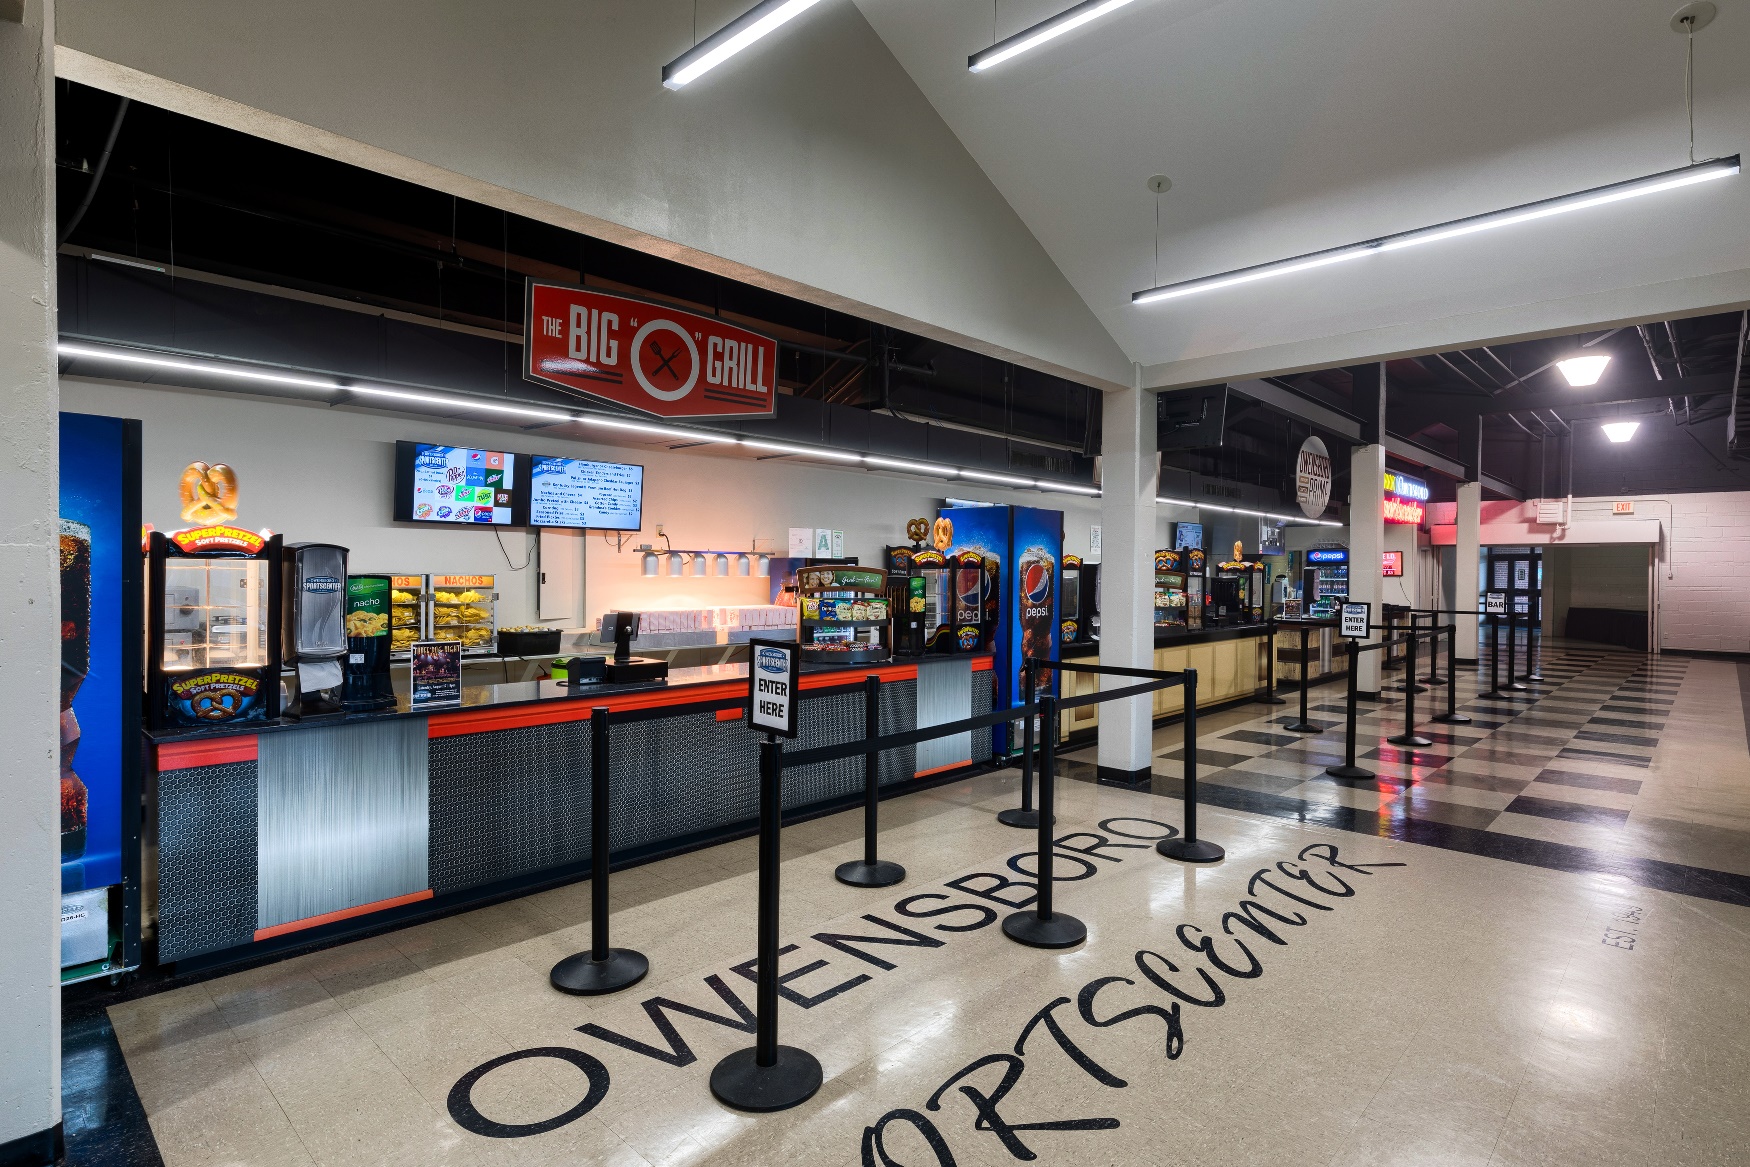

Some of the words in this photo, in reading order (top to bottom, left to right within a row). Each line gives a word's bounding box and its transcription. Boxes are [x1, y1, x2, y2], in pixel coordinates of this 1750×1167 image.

[542, 316, 562, 338] THE
[568, 304, 619, 366] BIG
[706, 336, 768, 393] GRILL
[1616, 503, 1631, 512] EXIT
[196, 537, 214, 545] SOFT
[215, 537, 248, 547] PRETZELS
[303, 582, 342, 591] SPORTSCENTER
[444, 576, 484, 586] NACHOS
[354, 598, 380, 608] nacho
[957, 609, 989, 622] pepi
[1026, 604, 1048, 619] pepsi
[172, 673, 257, 694] SUPERPRETZEL
[190, 685, 210, 694] SOFT
[758, 678, 788, 697] ENTER
[759, 700, 785, 718] HERE
[1601, 926, 1638, 951] EST.
[446, 817, 1178, 1138] OWENSBORO
